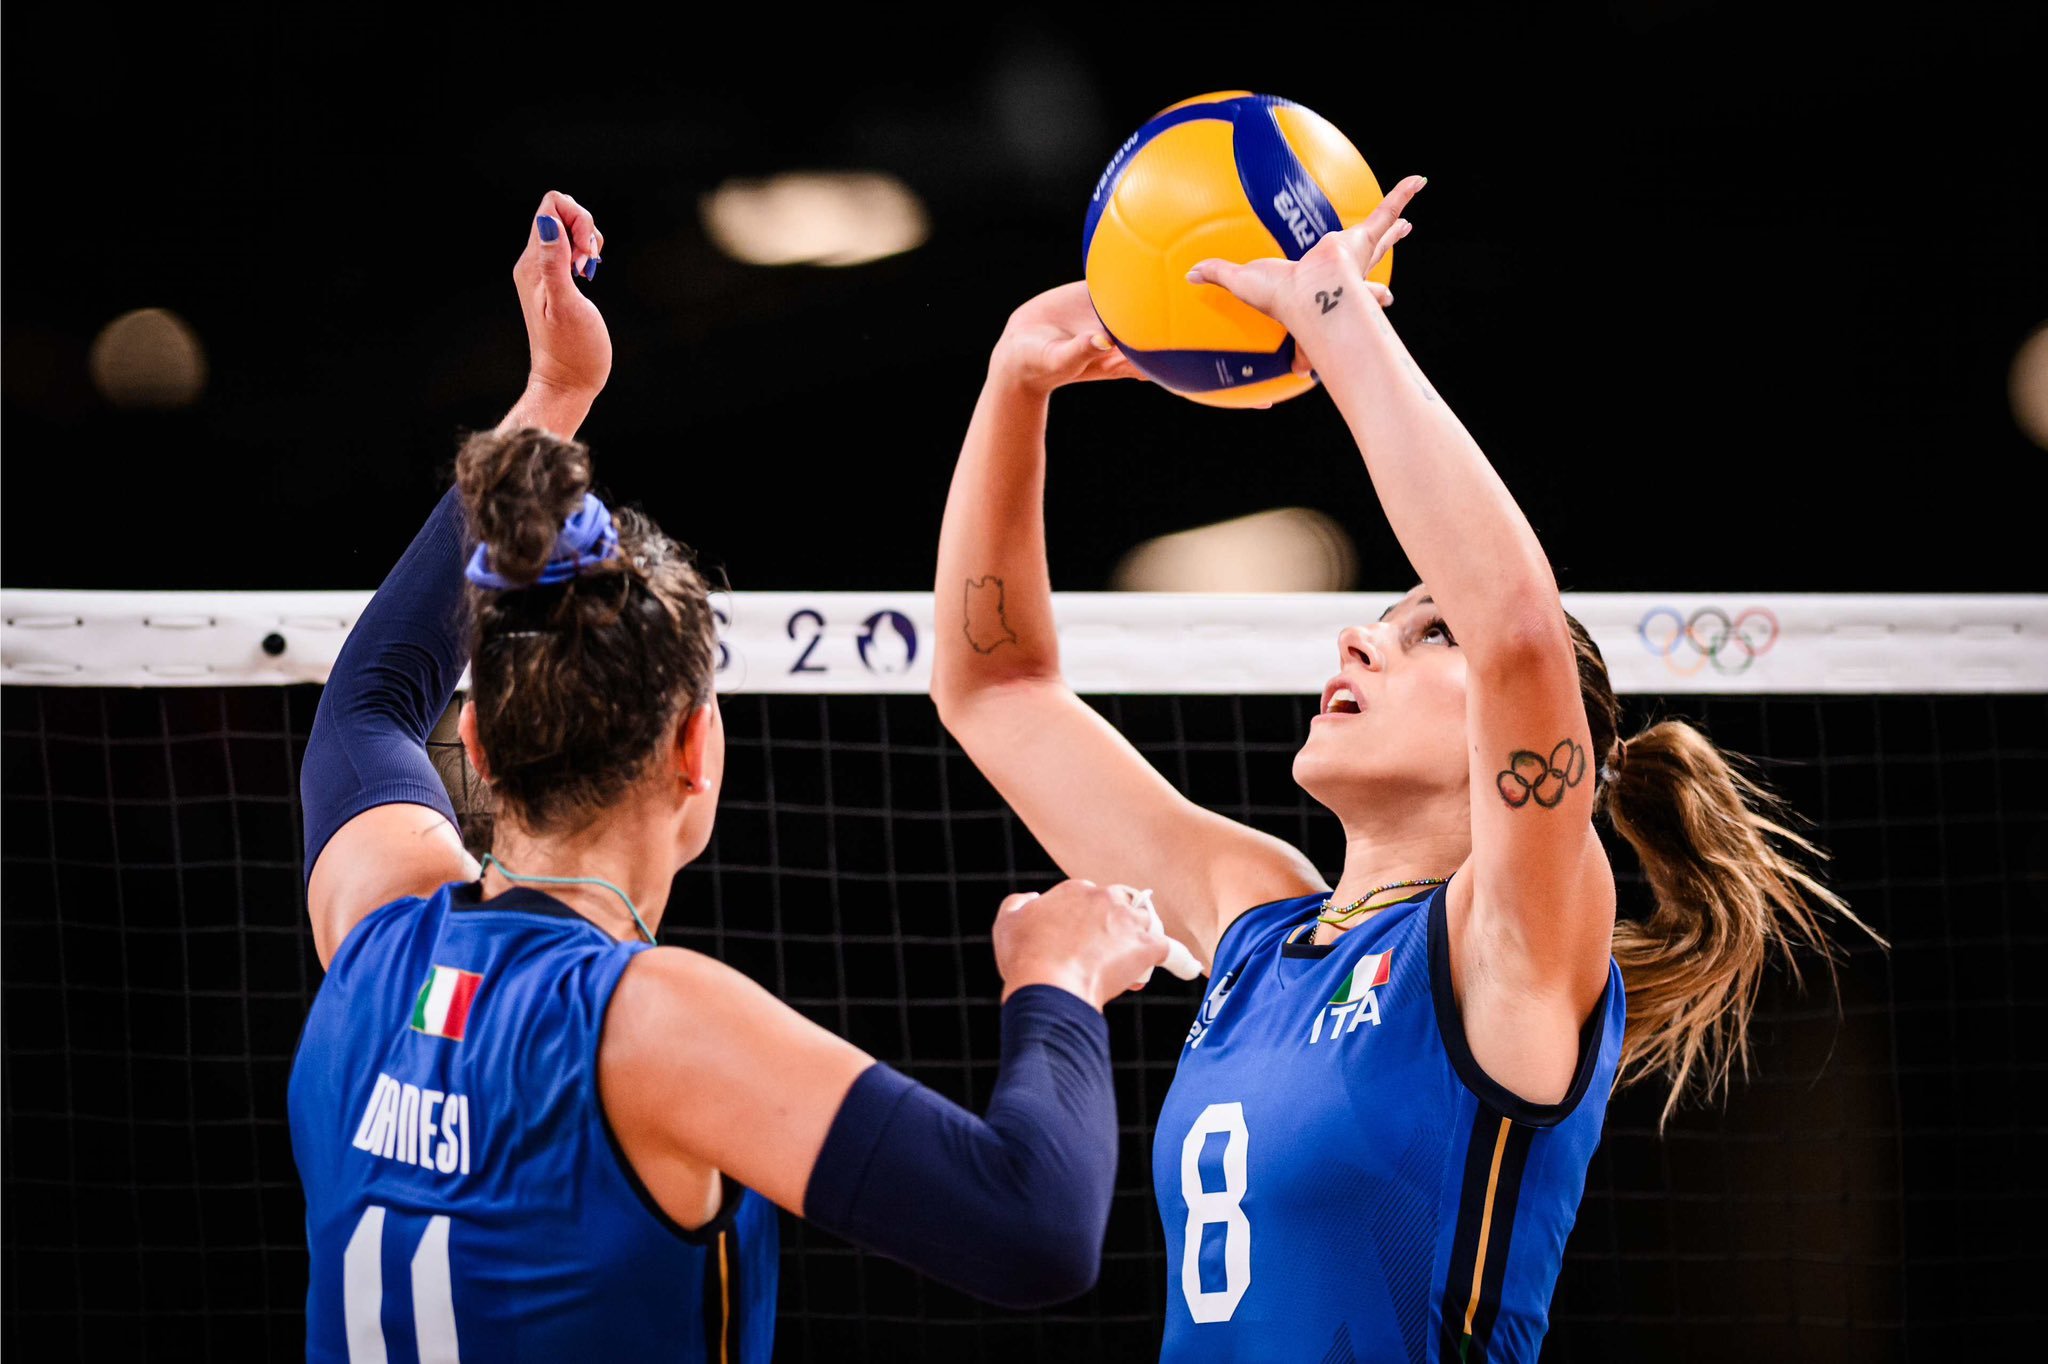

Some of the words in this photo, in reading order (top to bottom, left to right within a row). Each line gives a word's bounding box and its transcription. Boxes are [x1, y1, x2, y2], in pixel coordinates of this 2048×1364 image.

[1310, 990, 1381, 1044] ITA
[353, 1072, 470, 1175] DANESI
[1181, 1102, 1251, 1324] 8
[344, 1205, 461, 1364] 11
